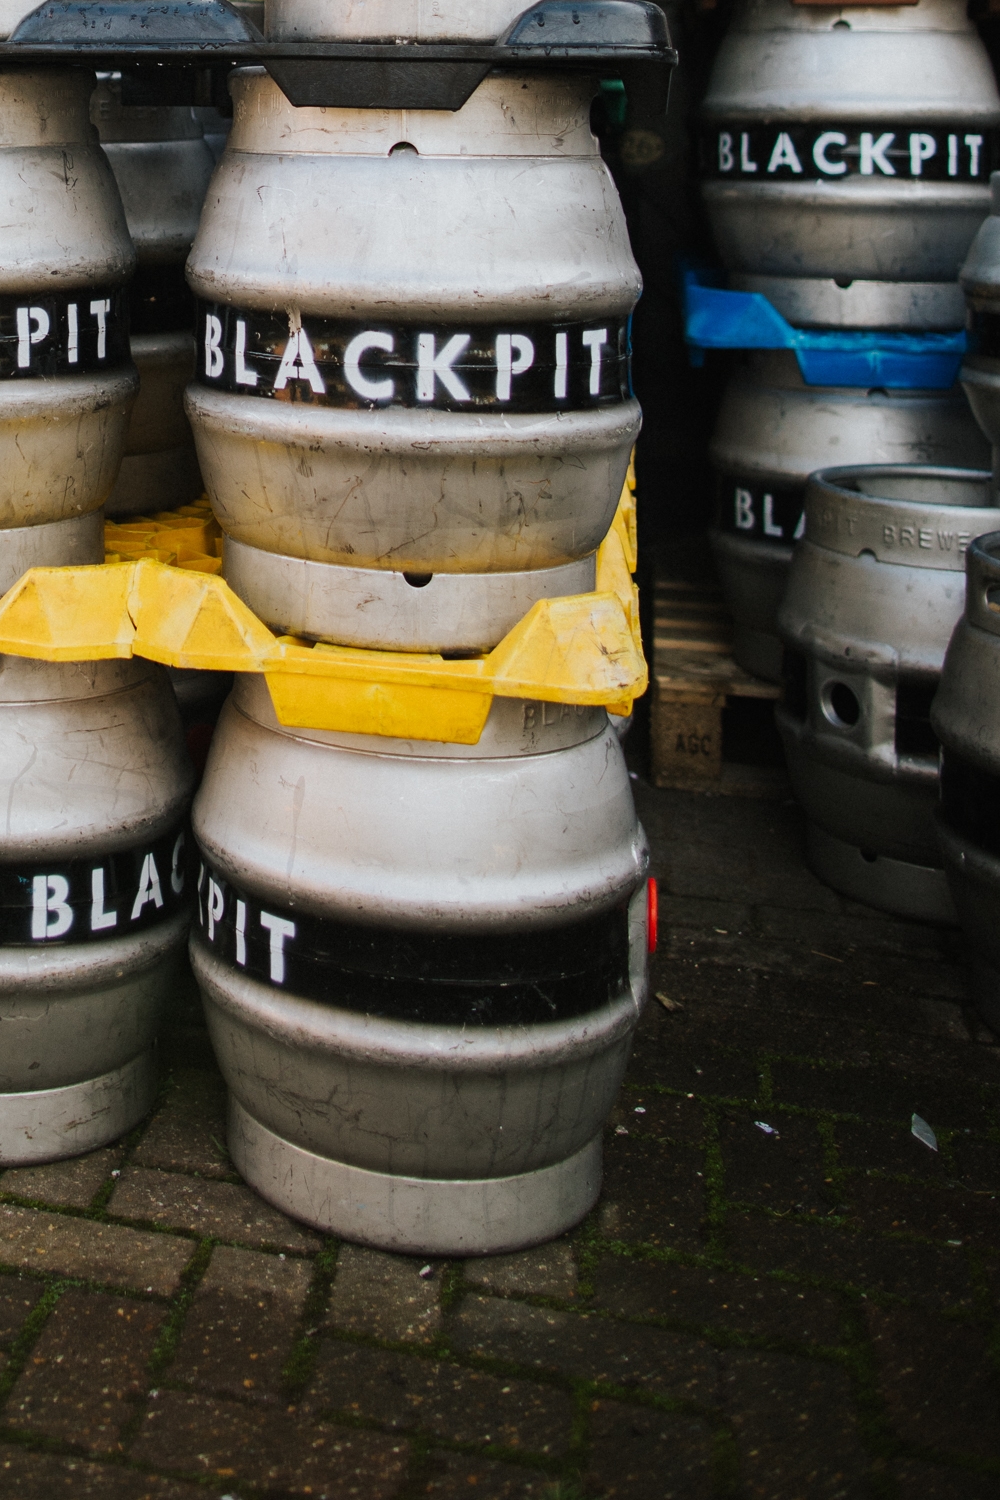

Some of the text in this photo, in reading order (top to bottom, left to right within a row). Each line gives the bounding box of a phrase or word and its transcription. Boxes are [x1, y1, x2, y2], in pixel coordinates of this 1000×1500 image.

[717, 131, 984, 177] BLACKPIT
[204, 314, 608, 402] BLACKPIT
[882, 522, 982, 552] BREWE
[197, 862, 297, 984] PIT
